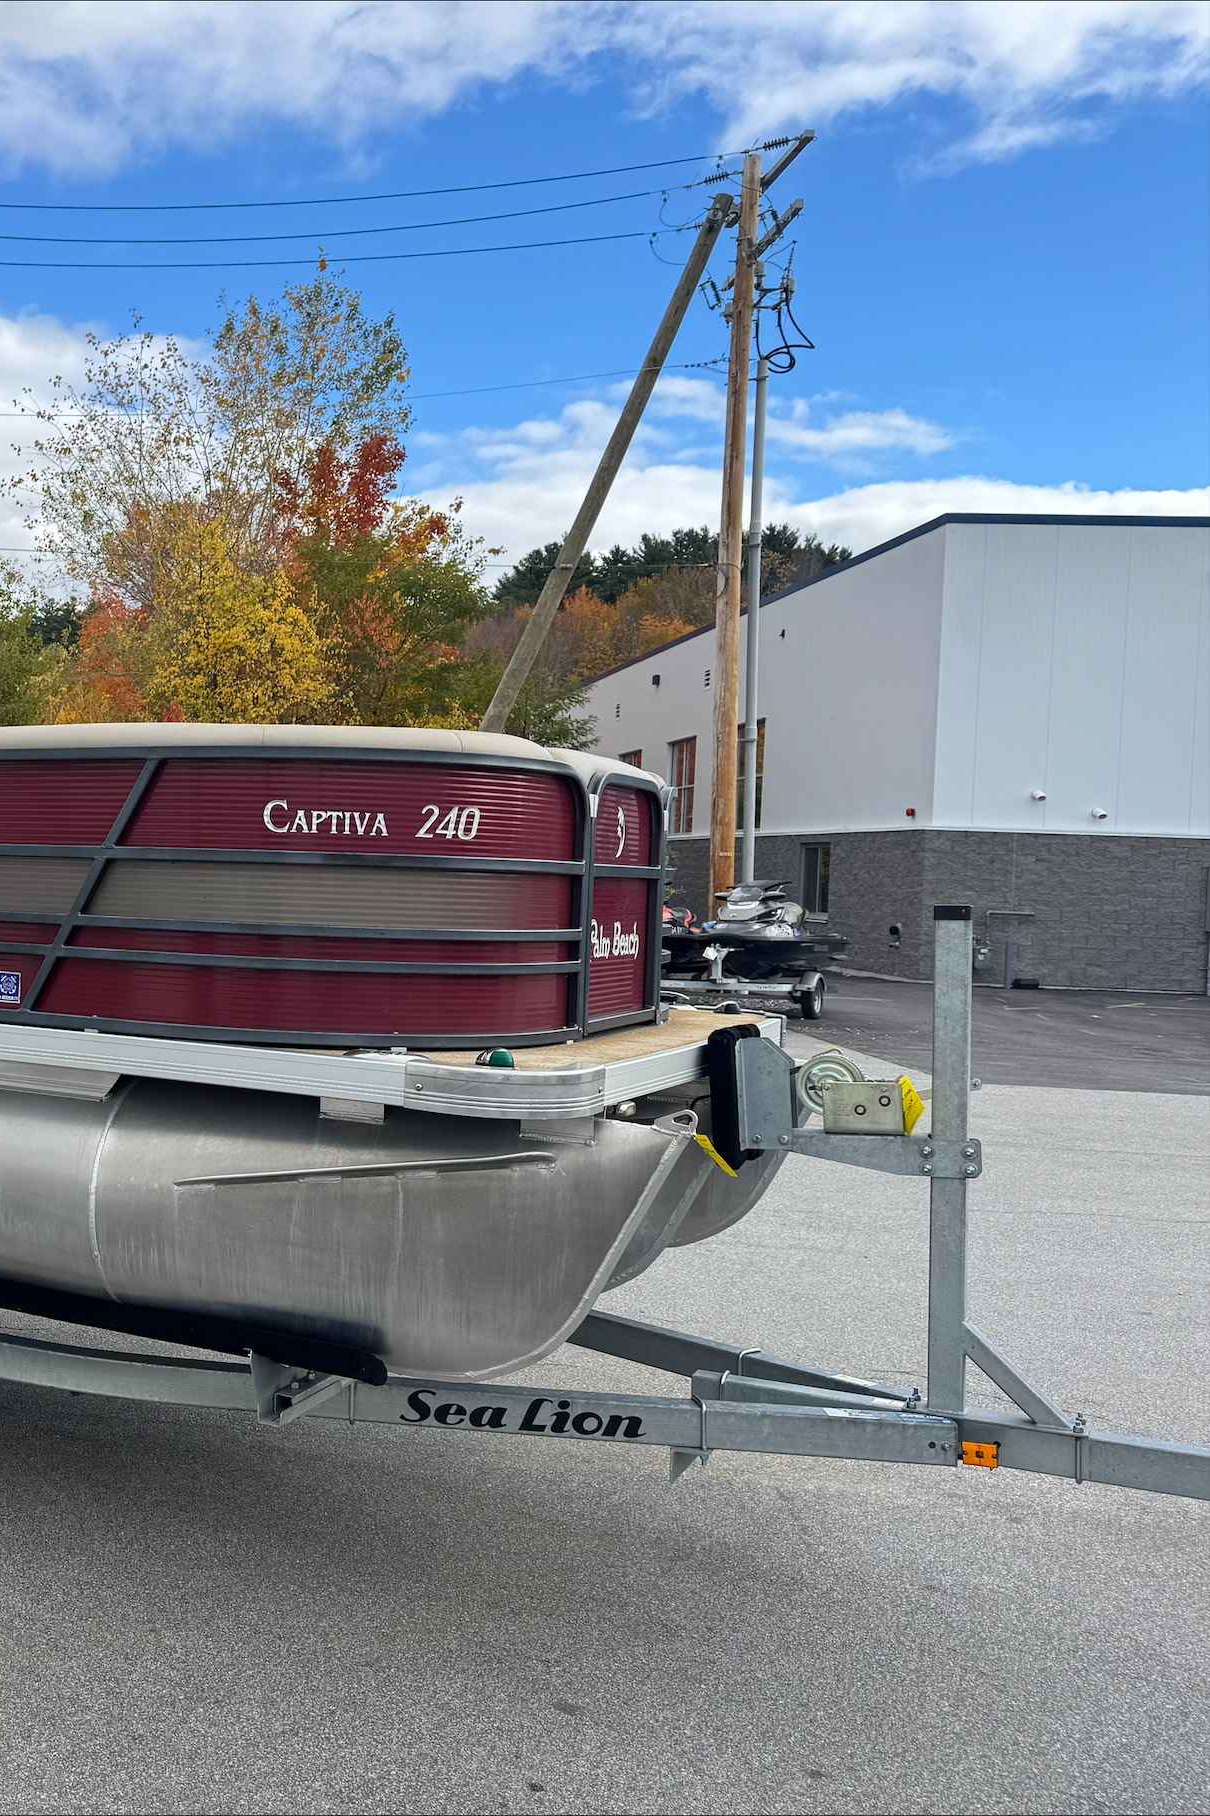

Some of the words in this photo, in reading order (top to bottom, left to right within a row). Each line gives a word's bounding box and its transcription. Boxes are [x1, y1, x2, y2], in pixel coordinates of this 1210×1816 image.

[262, 799, 389, 836] CAPTIVA
[415, 804, 481, 840] 240
[612, 921, 639, 959] Beach
[399, 1389, 508, 1428] Sea
[518, 1398, 646, 1438] Lion
